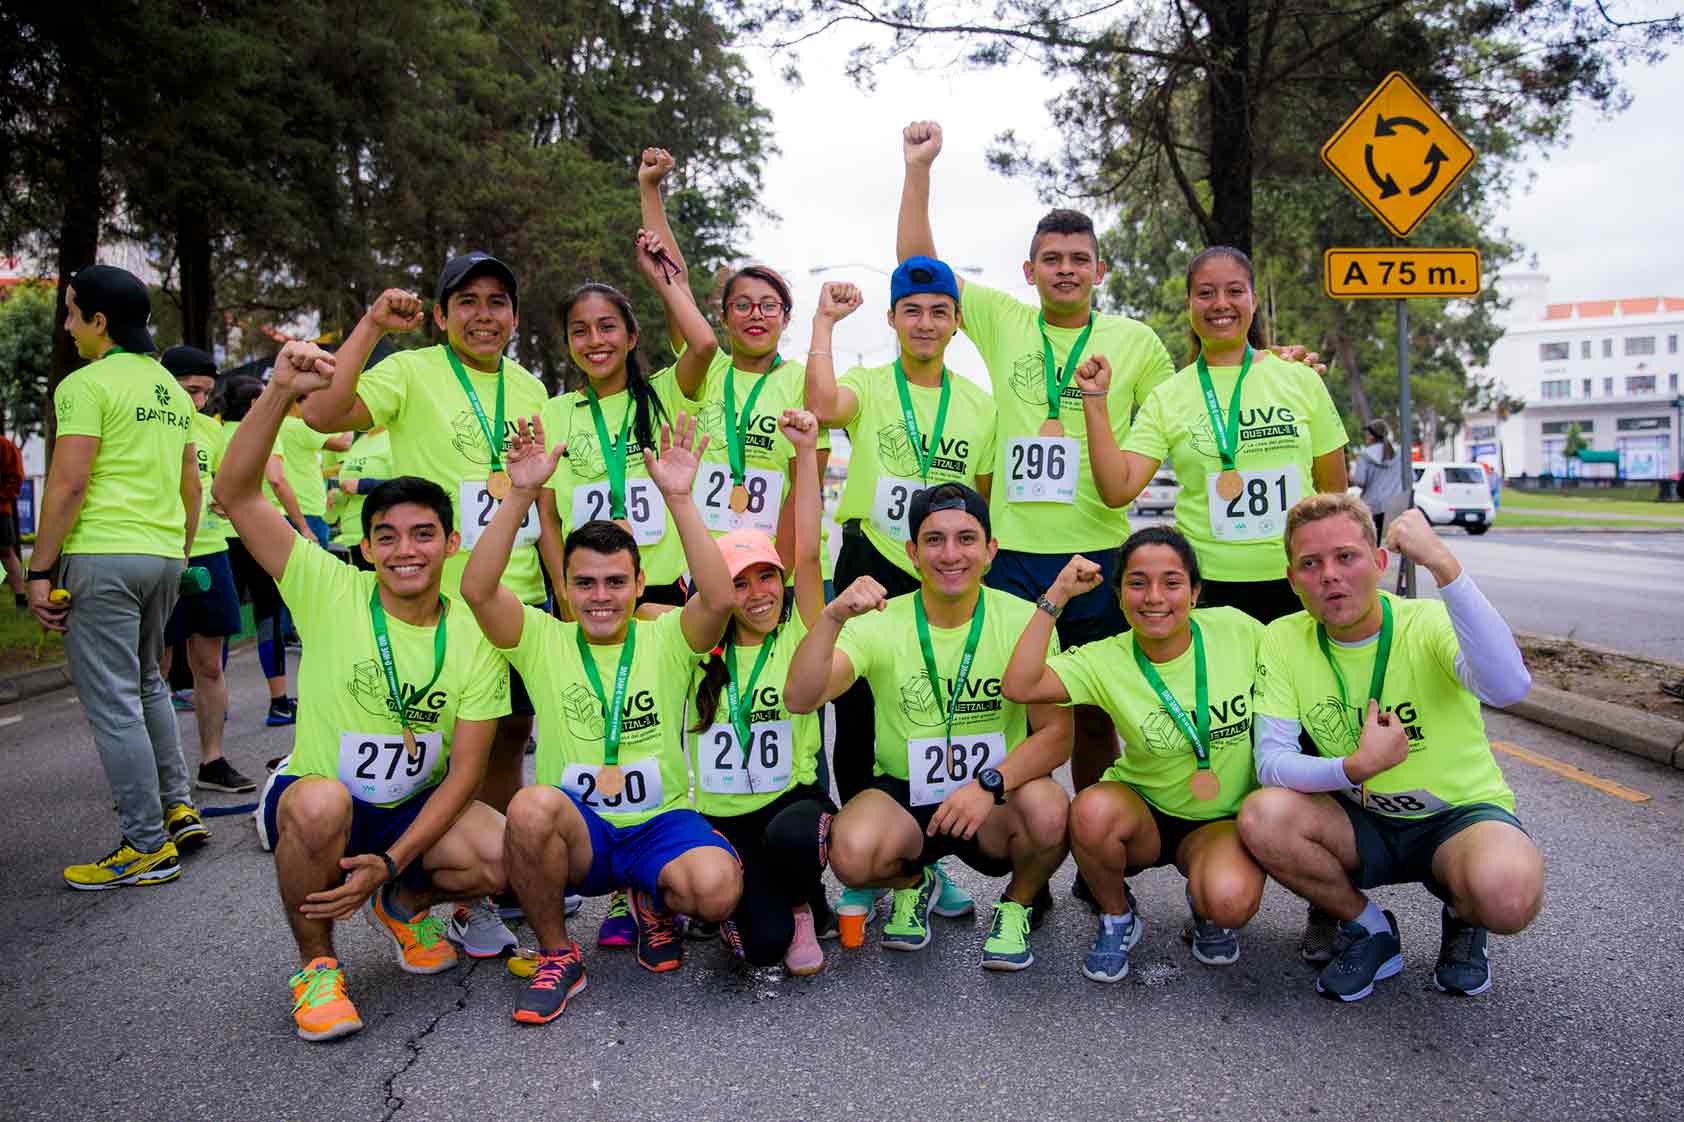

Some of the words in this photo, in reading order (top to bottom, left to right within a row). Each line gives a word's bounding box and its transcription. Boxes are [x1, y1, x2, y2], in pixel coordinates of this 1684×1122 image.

[1343, 261, 1368, 285] A
[1377, 261, 1416, 285] 75
[1428, 266, 1466, 285] m.
[1239, 406, 1295, 426] UVG
[1012, 443, 1066, 480] 296
[706, 471, 767, 514] 28
[947, 678, 1001, 698] UVG
[356, 741, 427, 780] 279
[925, 742, 990, 784] 282
